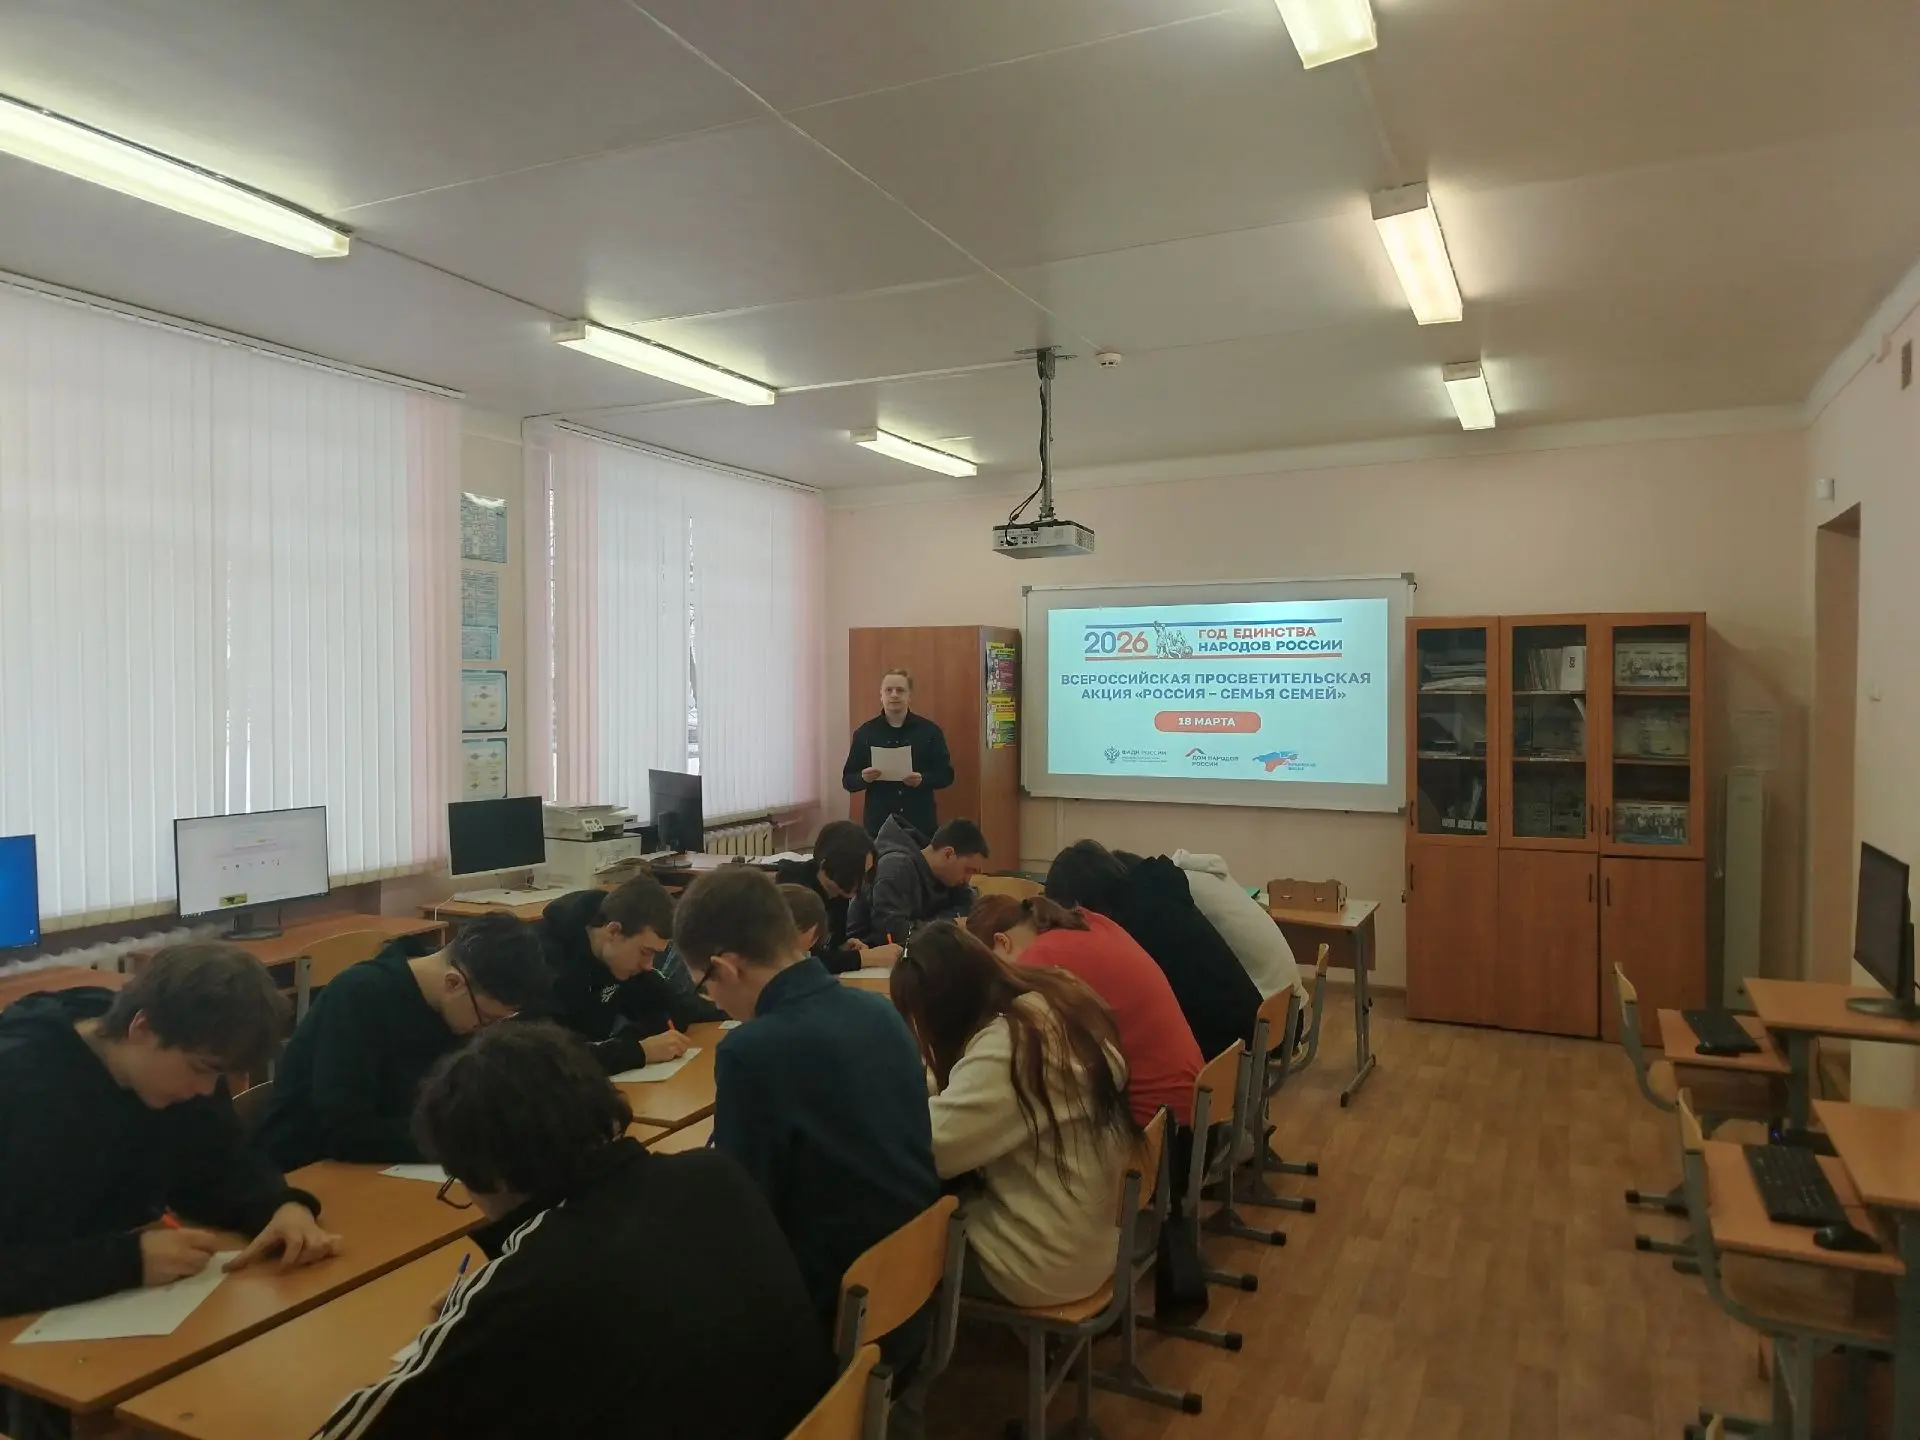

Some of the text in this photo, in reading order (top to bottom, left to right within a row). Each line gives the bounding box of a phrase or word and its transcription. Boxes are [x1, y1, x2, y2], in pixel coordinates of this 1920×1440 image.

[1198, 626, 1317, 640] ГОД ЕДИНСТВА
[1084, 631, 1149, 654] 2026
[1198, 639, 1343, 653] НАРОДОВ РОССИИ
[1061, 671, 1371, 685] ВСЕРОССИЙСКАЯ ПРОСВЕТИТЕЛЬСКАЯ
[1081, 688, 1132, 700] АКЦИЯ
[1135, 688, 1206, 699] «РОССИЯ
[1220, 688, 1275, 700] СЕМЬЯ
[1279, 685, 1346, 700] СЕМЕЙ»
[1178, 717, 1236, 727] 18 МАРТА
